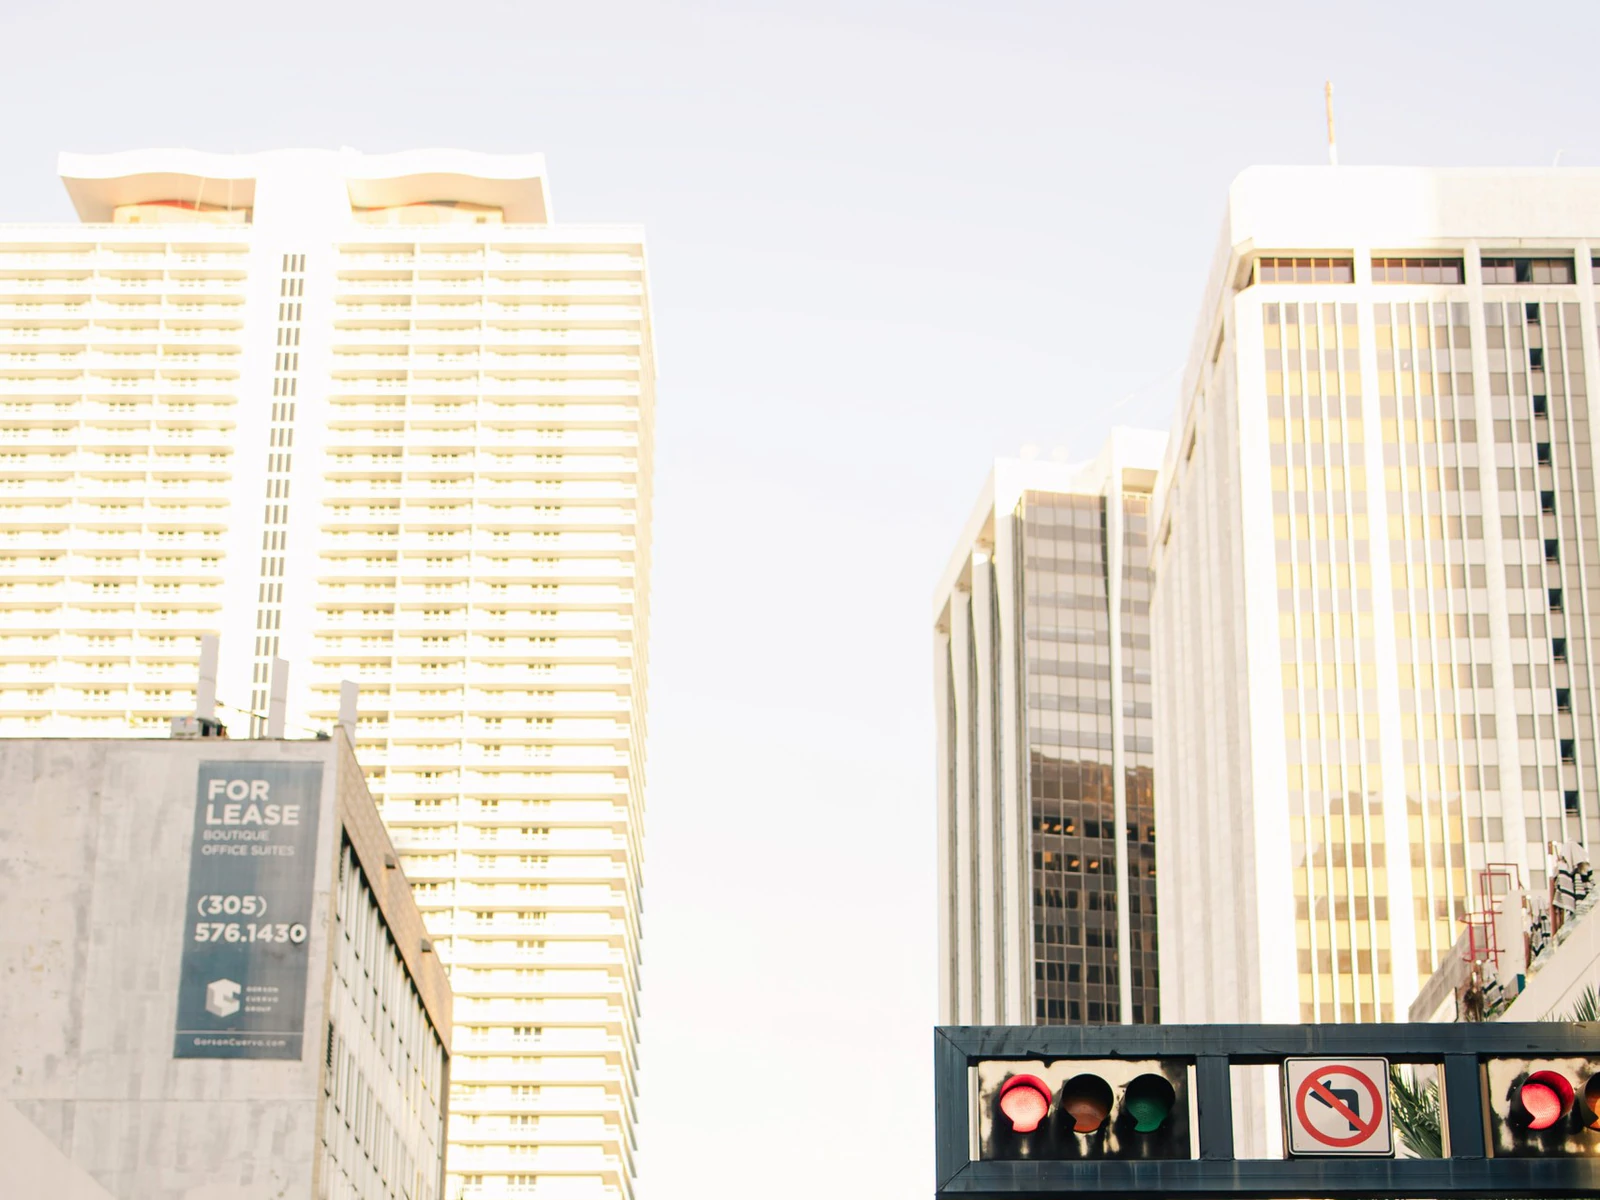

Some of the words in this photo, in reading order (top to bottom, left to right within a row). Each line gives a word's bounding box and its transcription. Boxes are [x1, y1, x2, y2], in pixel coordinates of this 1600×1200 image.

[208, 779, 270, 801] FOR
[206, 804, 300, 825] LEASE
[203, 829, 270, 841] BOUTIQUE
[201, 844, 248, 856] OFFICE
[251, 845, 295, 857] SUITES
[197, 895, 267, 918] (305)
[194, 922, 307, 943] 576.1430
